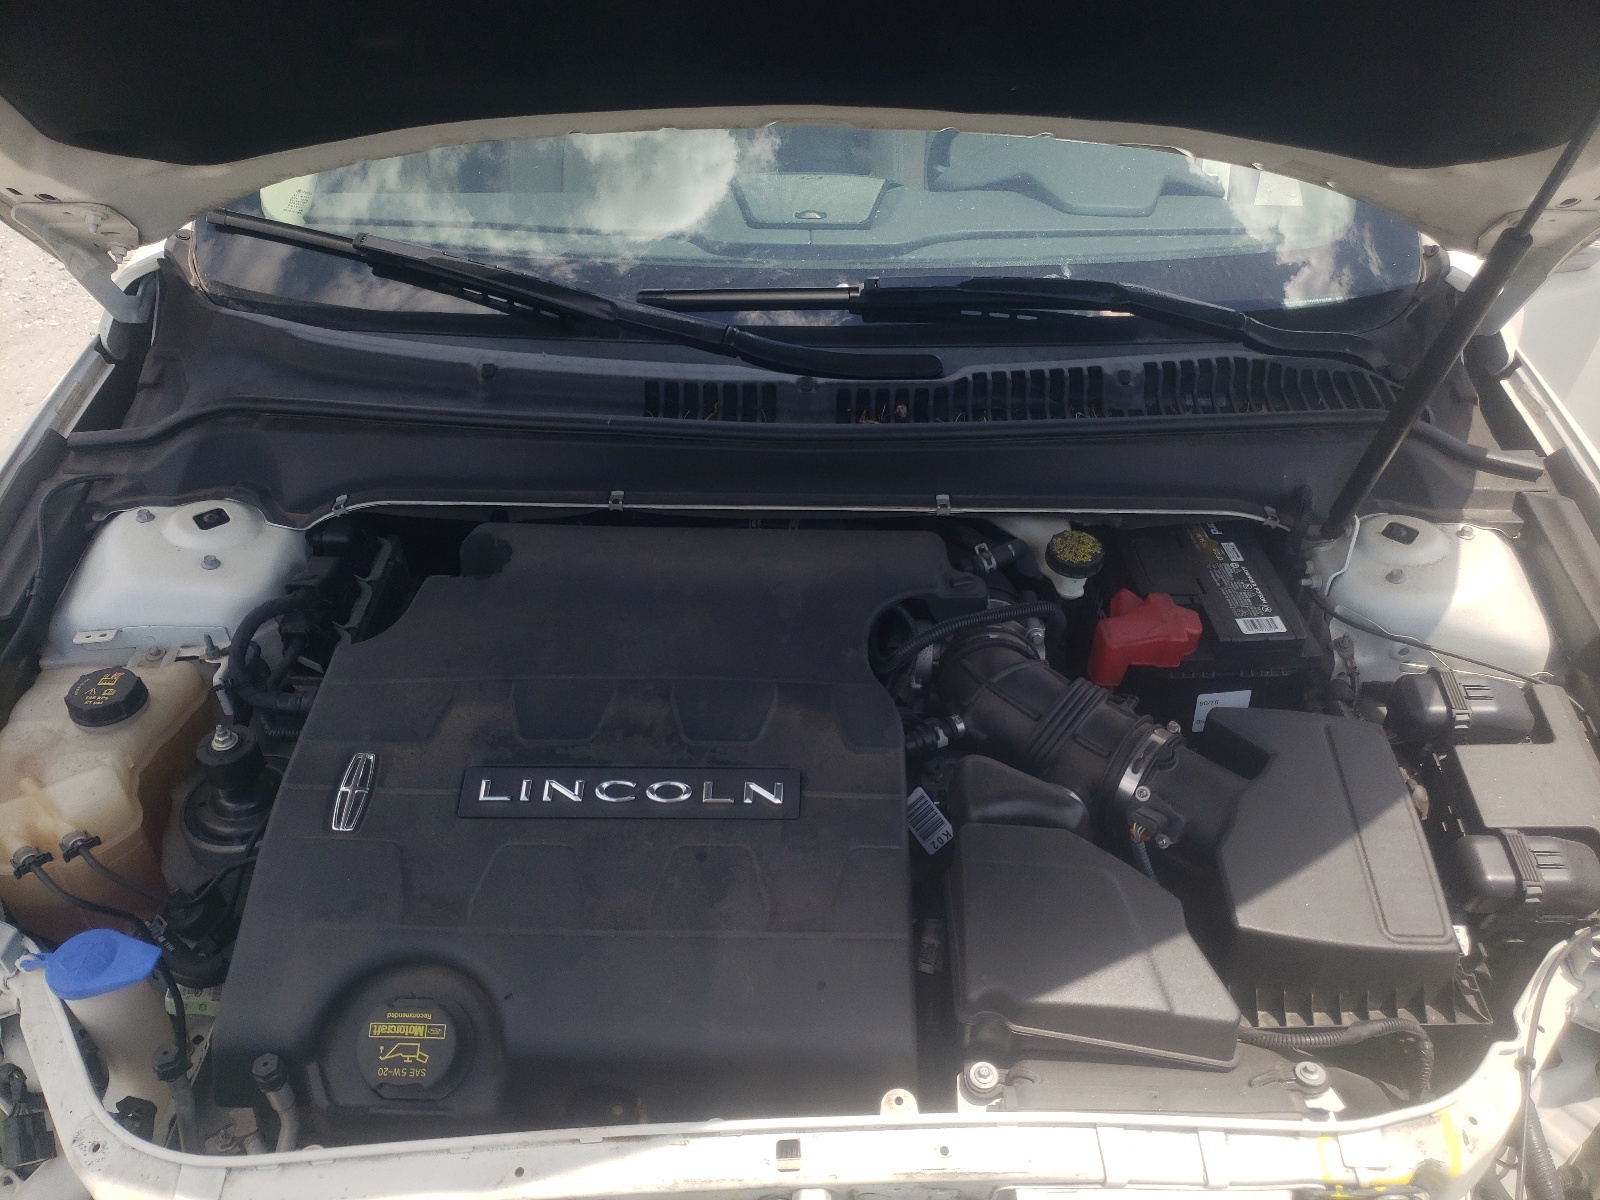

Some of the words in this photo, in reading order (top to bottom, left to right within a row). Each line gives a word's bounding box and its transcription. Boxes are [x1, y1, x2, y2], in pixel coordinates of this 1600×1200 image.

[478, 779, 784, 804] LINCOLN
[386, 1012, 432, 1020] Recommended
[372, 1024, 425, 1037] Motorcraft
[377, 1067, 407, 1077] 5W-20
[409, 1068, 426, 1077] SAE
